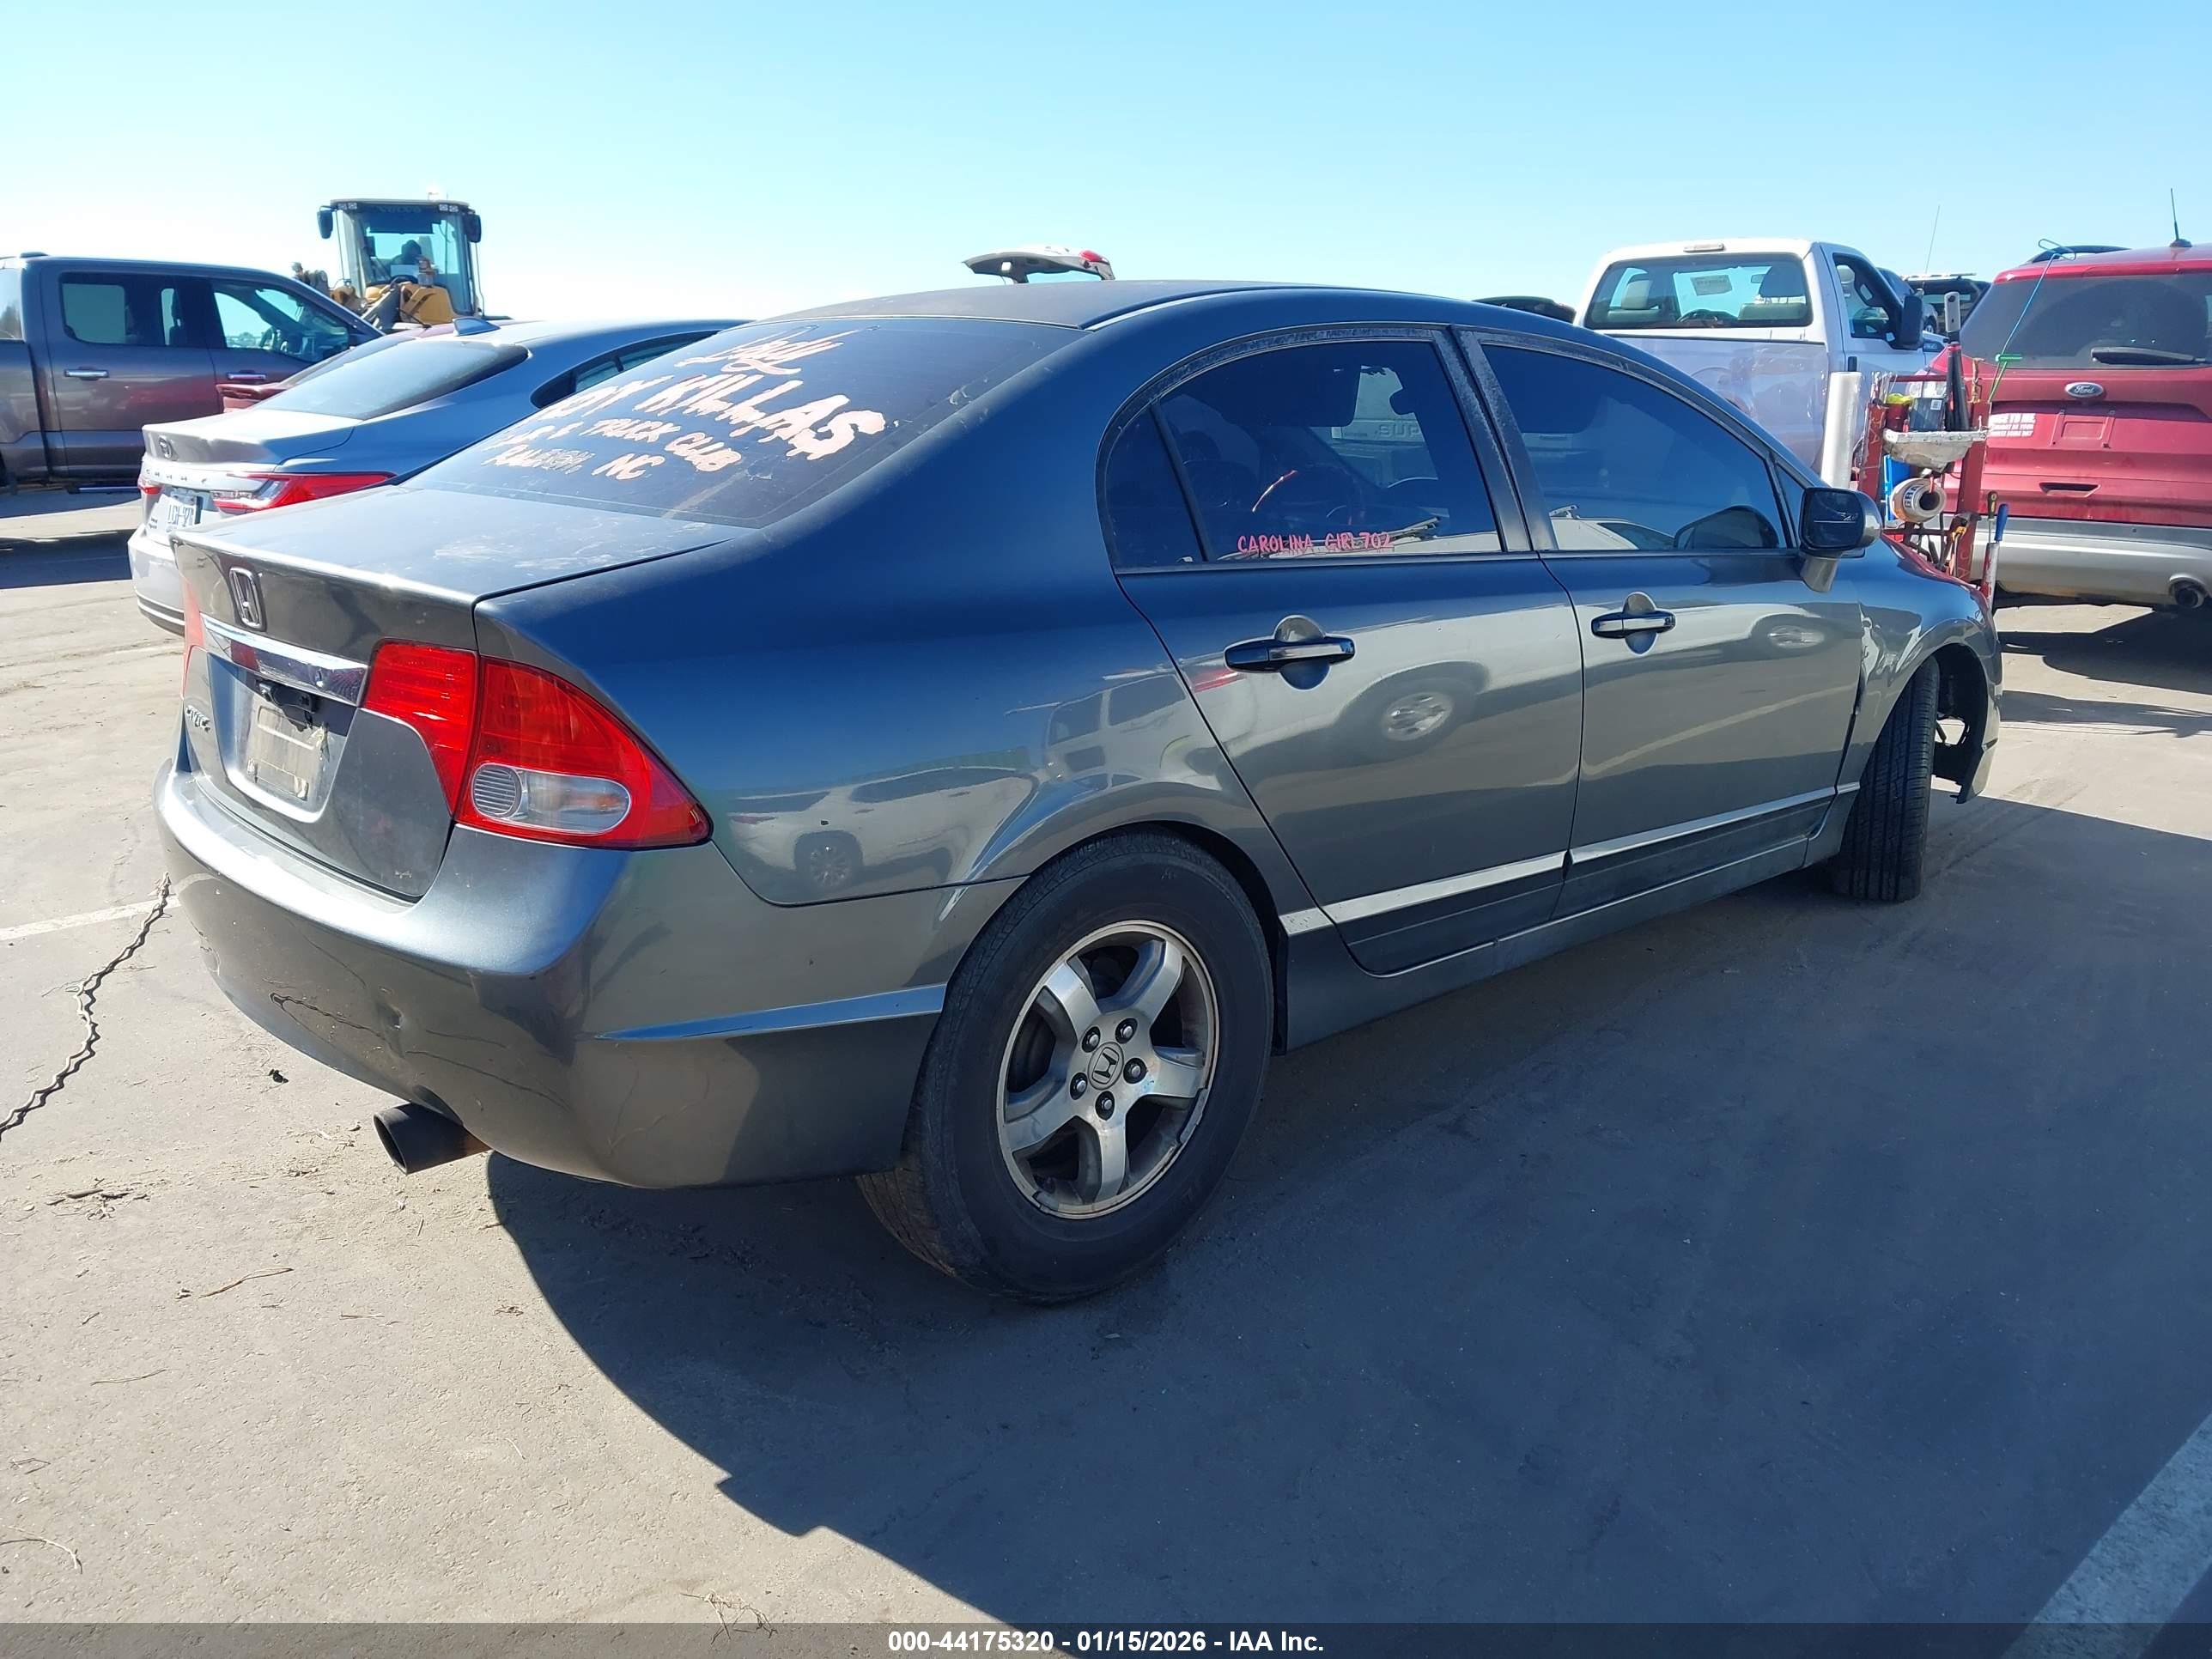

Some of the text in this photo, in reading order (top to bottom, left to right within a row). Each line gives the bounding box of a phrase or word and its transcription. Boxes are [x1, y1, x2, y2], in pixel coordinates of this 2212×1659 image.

[632, 372, 885, 460] KILLAS
[578, 418, 681, 442] TRUCK
[664, 432, 743, 472] CLUB
[591, 453, 665, 480] NC
[1237, 532, 1395, 553] CAROLINA GIRL 702
